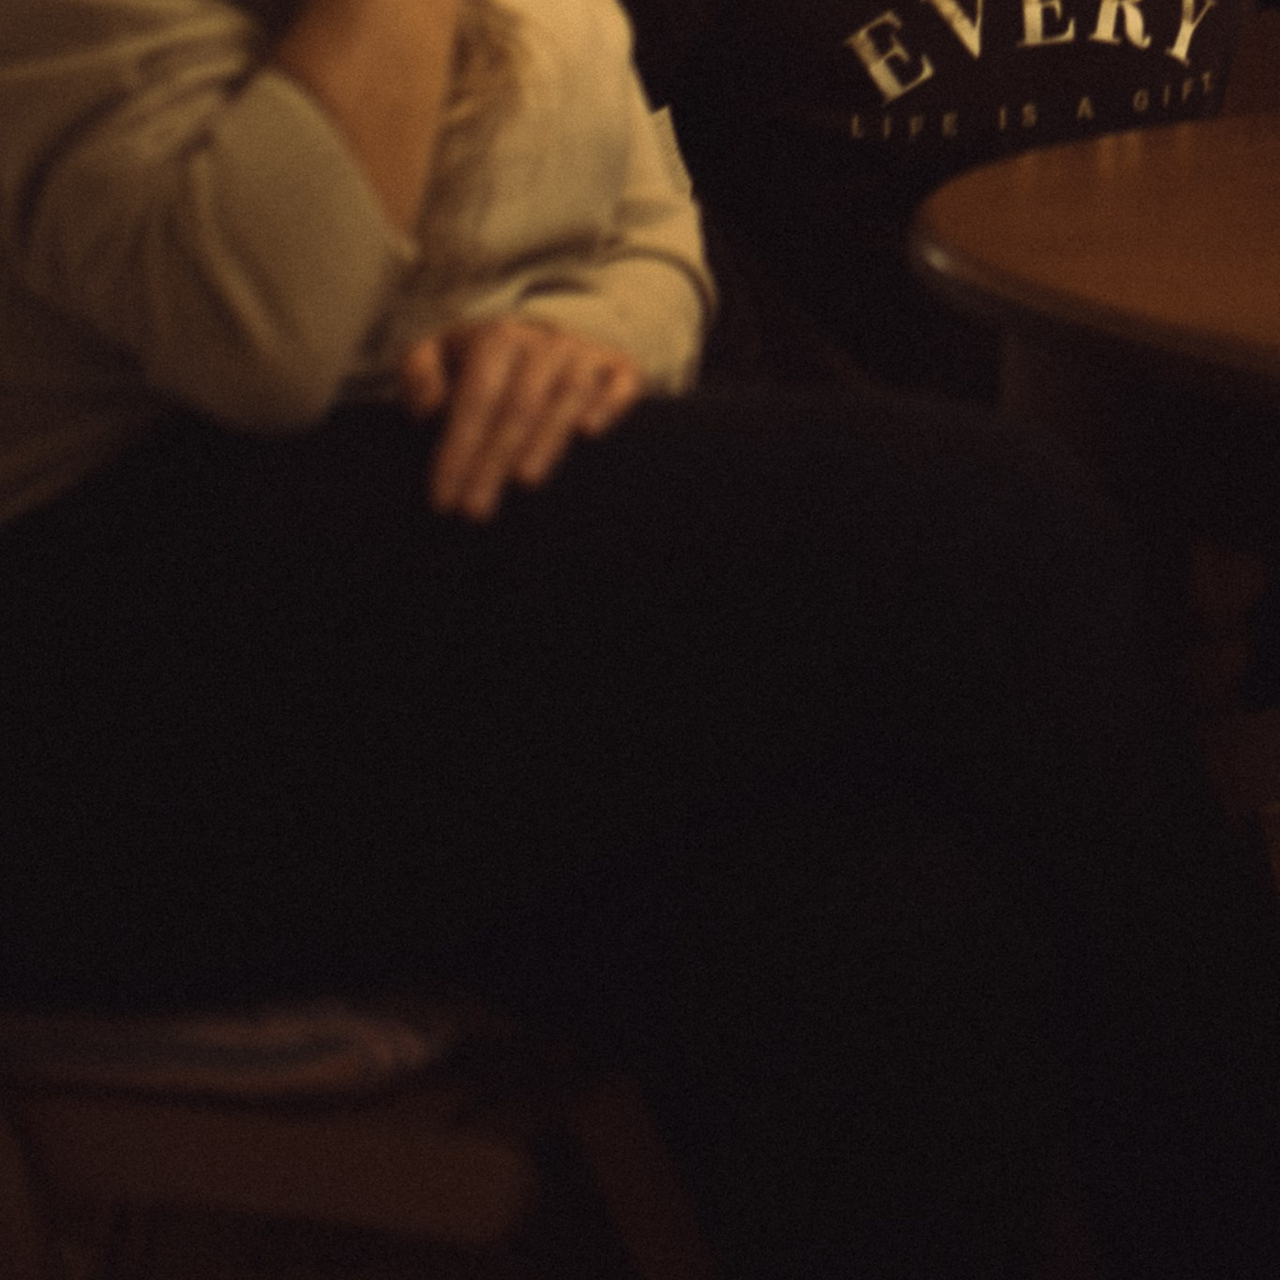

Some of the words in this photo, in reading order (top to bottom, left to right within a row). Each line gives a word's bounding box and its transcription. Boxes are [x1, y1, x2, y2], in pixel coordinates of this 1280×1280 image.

[850, 111, 959, 139] LIFE
[998, 102, 1039, 131] IS
[1076, 95, 1095, 122] A
[1131, 70, 1214, 113] GIFT
